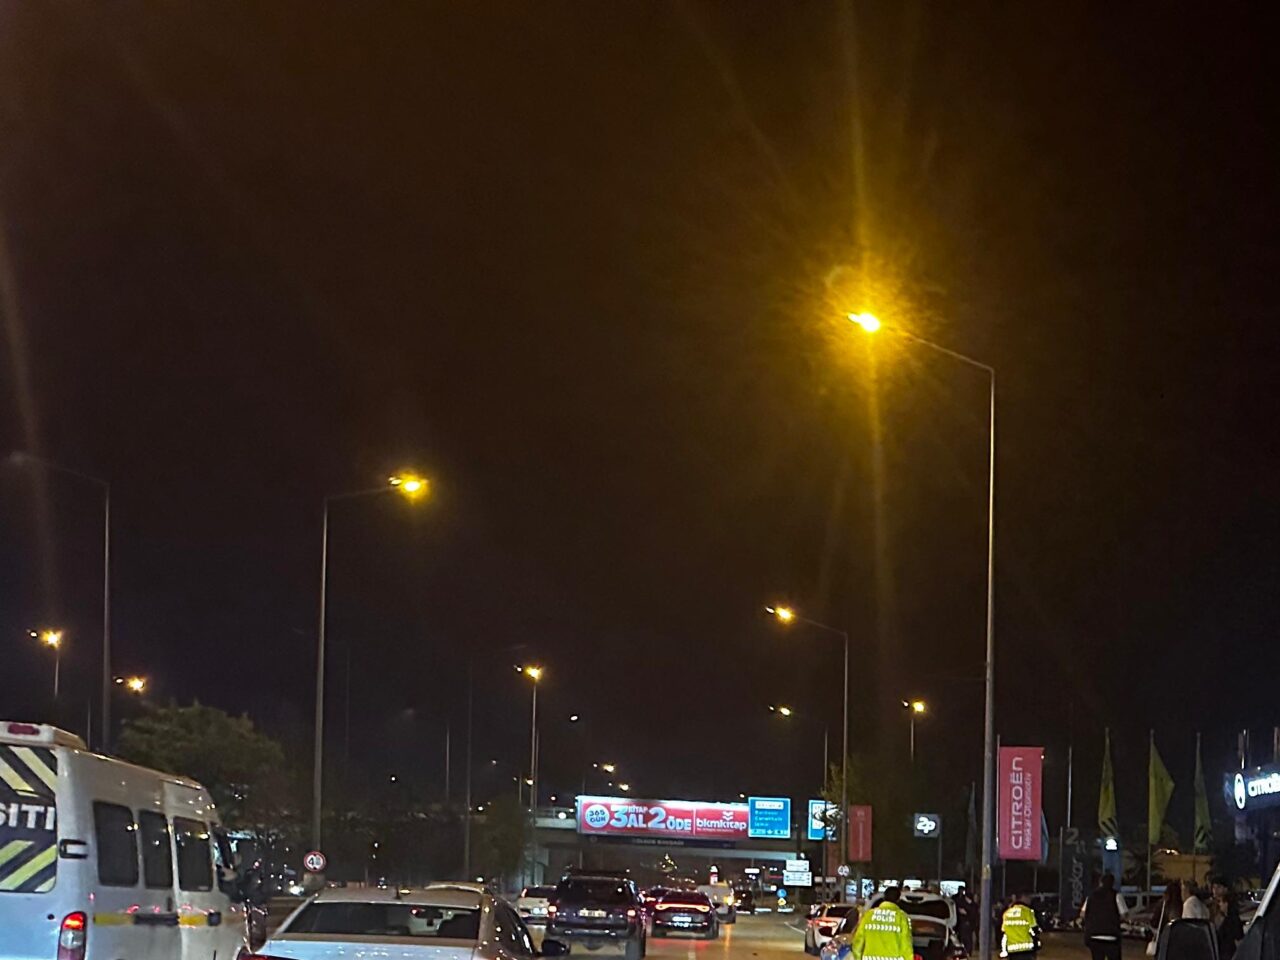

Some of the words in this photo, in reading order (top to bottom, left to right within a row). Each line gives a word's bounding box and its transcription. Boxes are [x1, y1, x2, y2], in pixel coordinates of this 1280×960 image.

[610, 805, 629, 828] 3
[627, 813, 647, 828] AL
[648, 806, 667, 829] 2
[666, 815, 692, 831] ÖDE
[696, 817, 747, 831] bkmkitap
